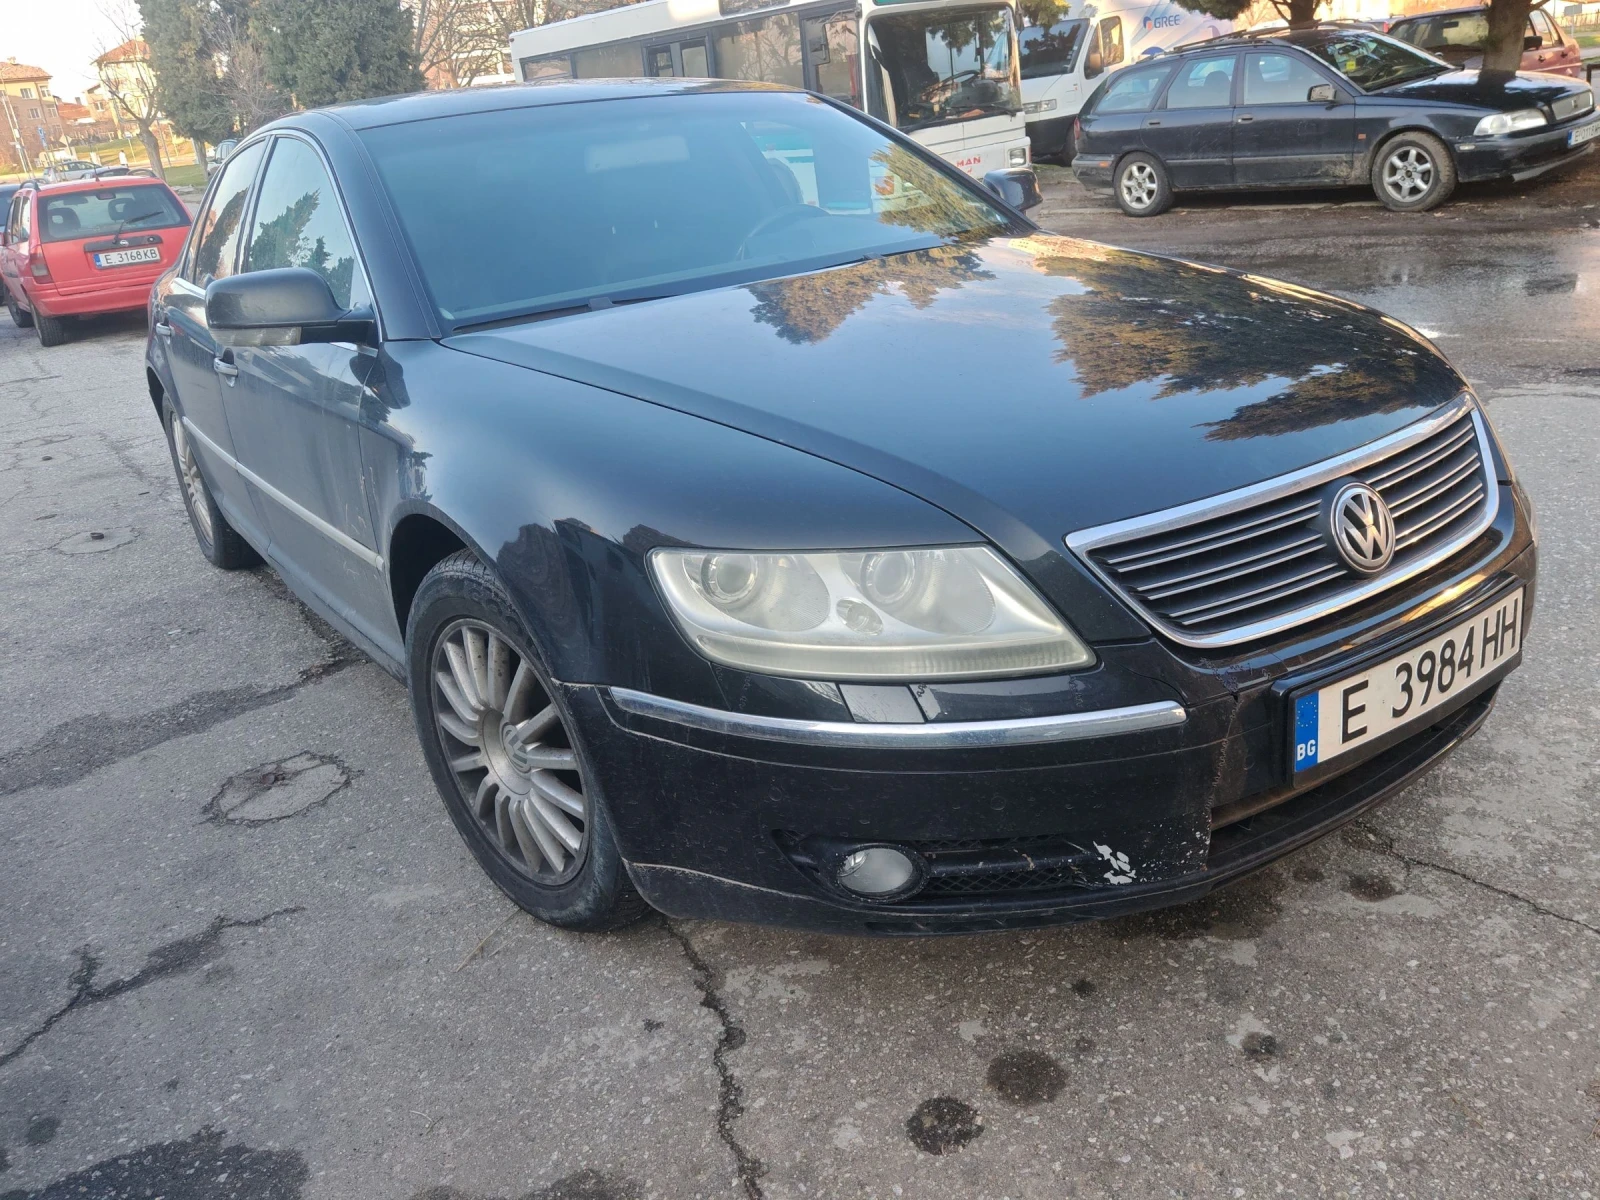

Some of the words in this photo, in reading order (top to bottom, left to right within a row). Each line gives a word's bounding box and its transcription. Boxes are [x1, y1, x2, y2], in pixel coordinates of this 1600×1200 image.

[1154, 14, 1181, 29] GREE
[956, 156, 981, 167] MAN
[1341, 679, 1369, 744] E
[1297, 740, 1316, 761] BG
